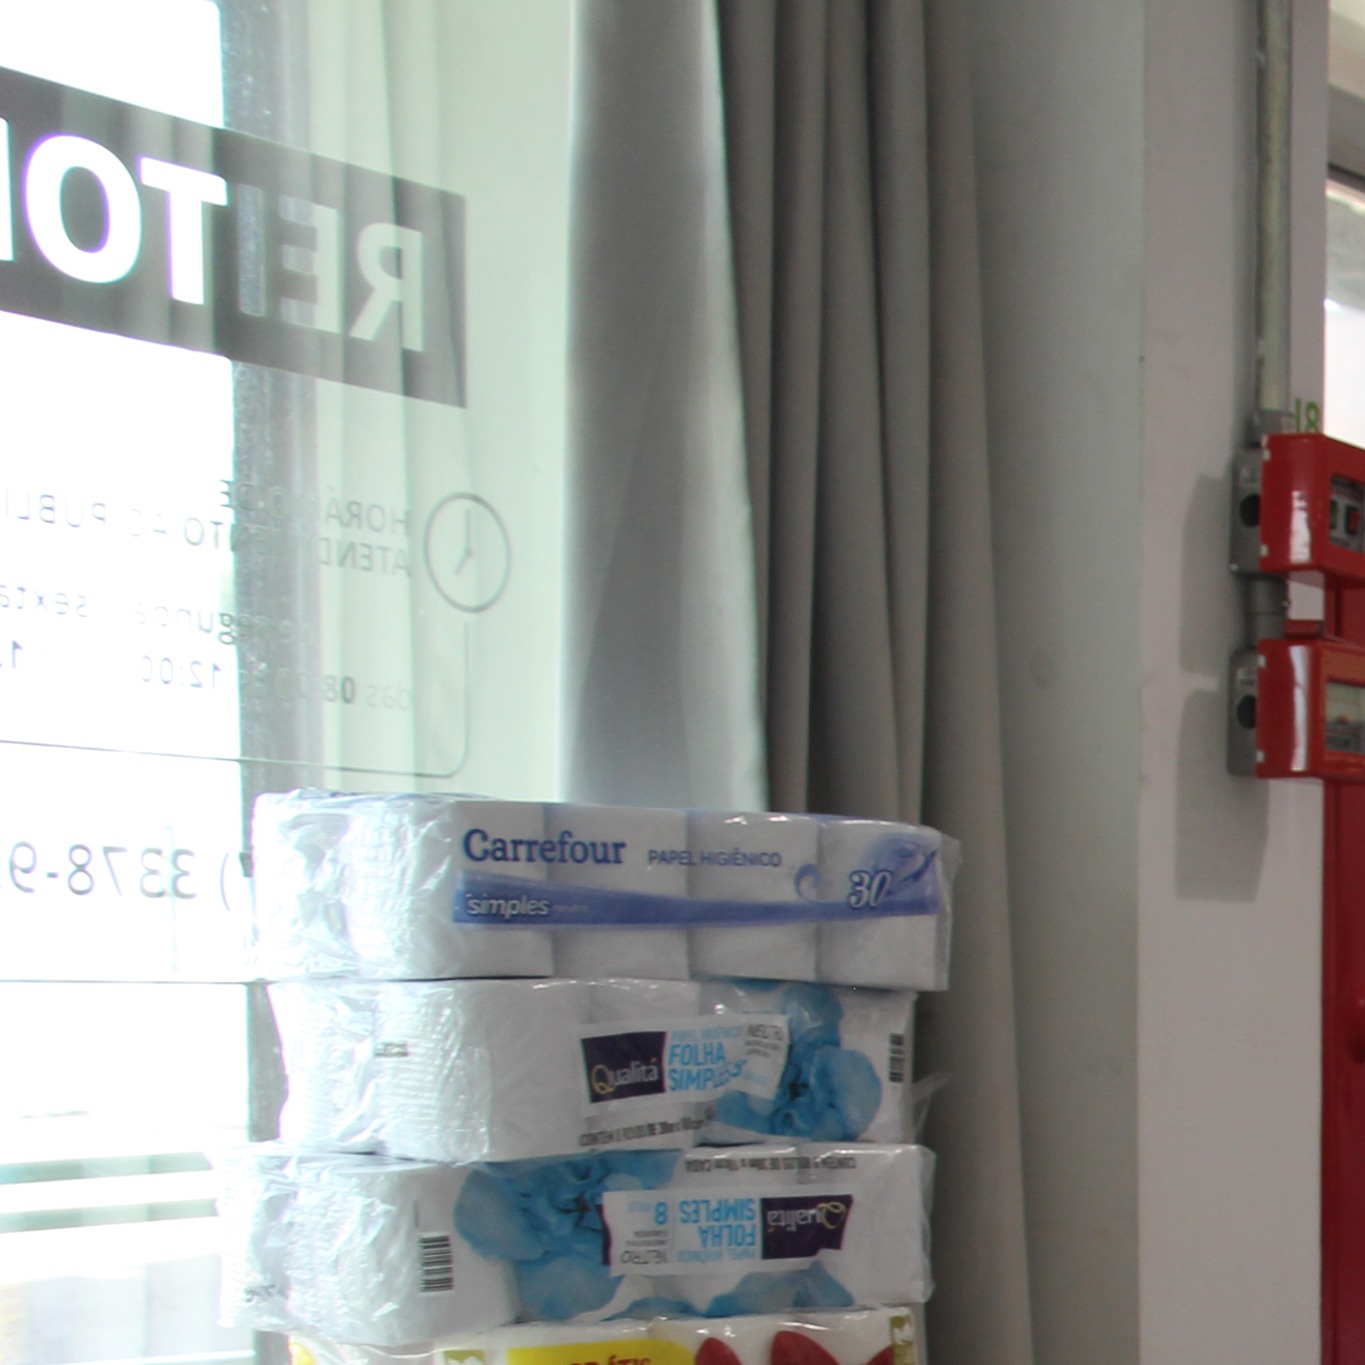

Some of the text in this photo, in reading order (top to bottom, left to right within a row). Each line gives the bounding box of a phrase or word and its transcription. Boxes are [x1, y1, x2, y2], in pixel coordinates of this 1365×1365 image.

[463, 828, 626, 866] Carrefour
[647, 847, 783, 867] PAPEL HIGIÊNICO
[465, 894, 549, 920] simples
[668, 1041, 725, 1067] FOLHA
[590, 1057, 659, 1095] Qualitá
[668, 1059, 747, 1092] SIMPLES
[655, 1202, 668, 1225] 8
[679, 1198, 755, 1224] SIMPLES
[766, 1201, 846, 1233] Qualitá
[700, 1226, 756, 1248] FOLHA
